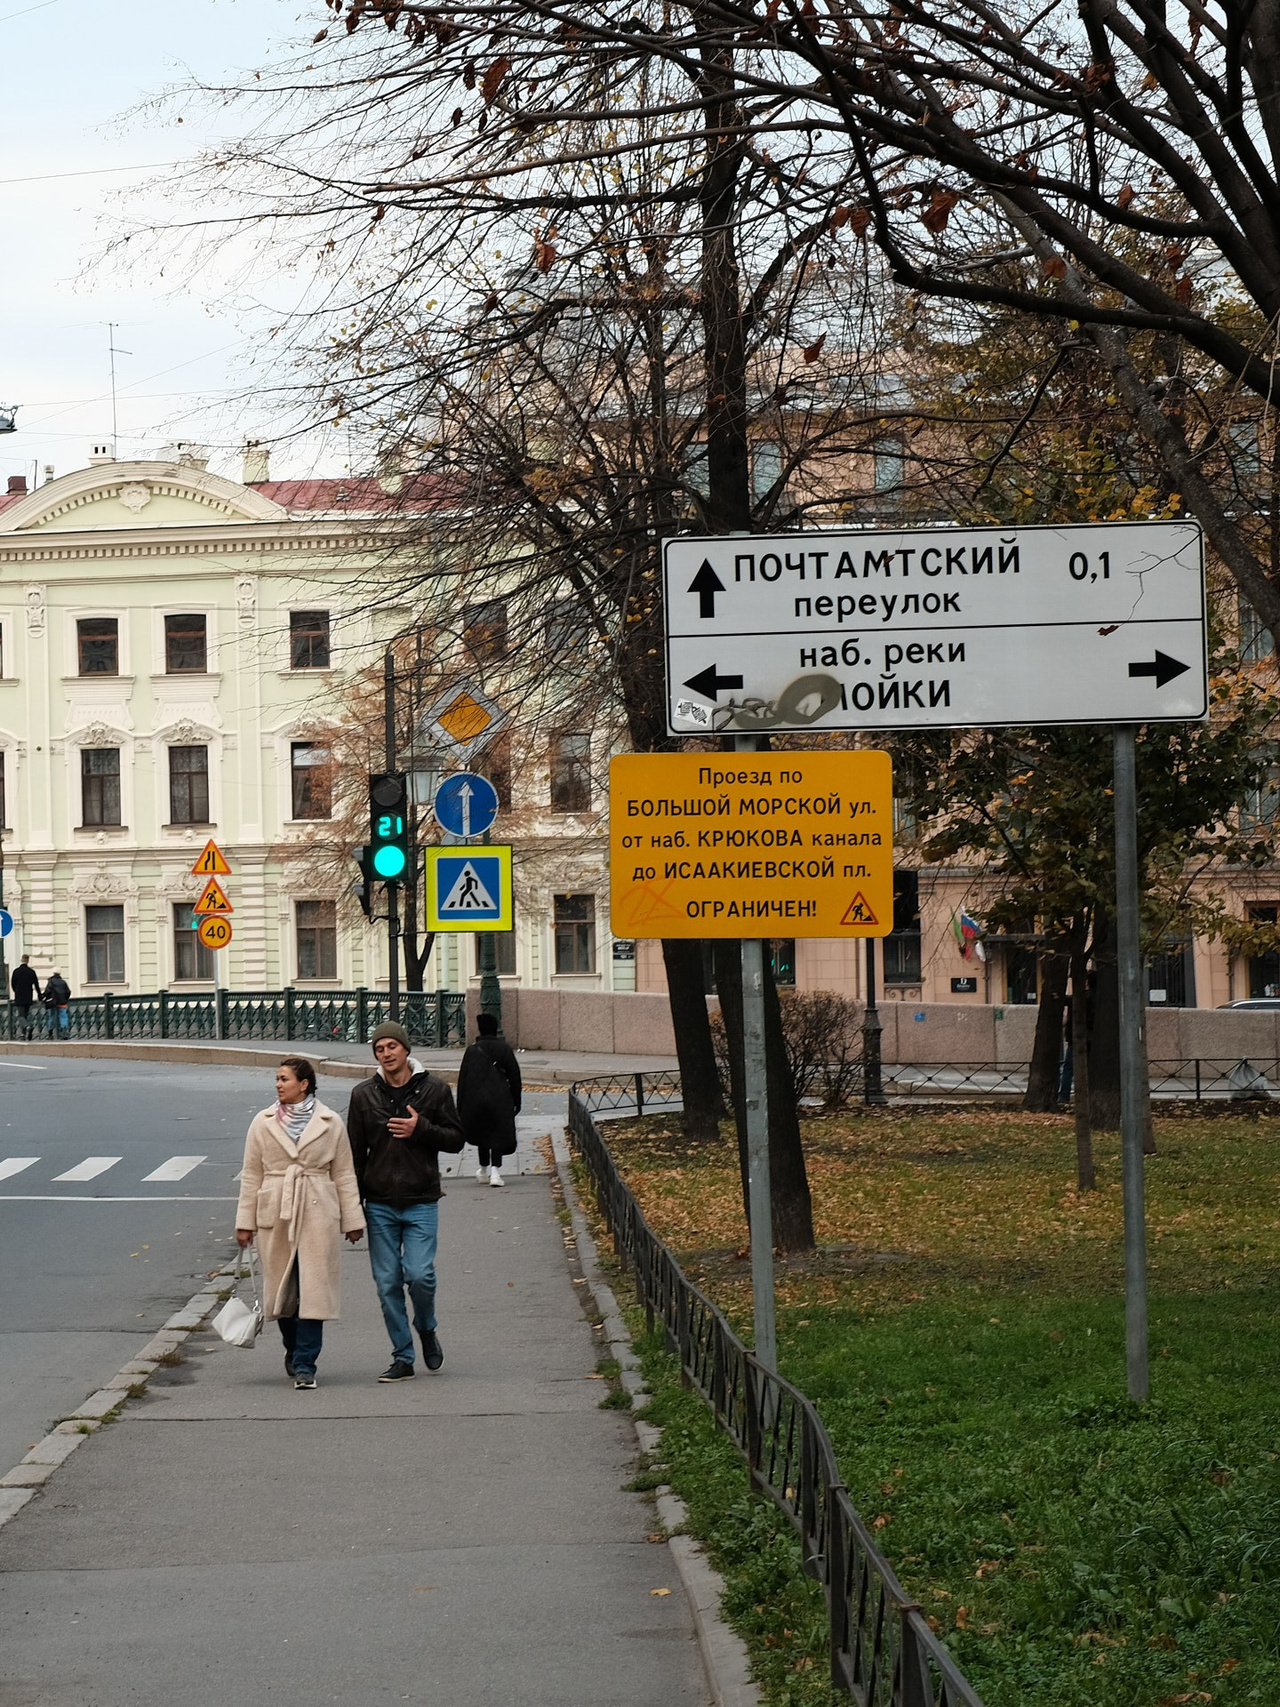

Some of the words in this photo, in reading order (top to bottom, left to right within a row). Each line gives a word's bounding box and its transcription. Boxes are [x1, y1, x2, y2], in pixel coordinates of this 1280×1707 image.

[733, 536, 1021, 583] ПОЧТАМТСКИЙ
[1068, 551, 1111, 584] 0,1
[793, 591, 963, 624] переулок
[799, 637, 873, 668] наб.
[883, 642, 967, 674] реки
[698, 767, 773, 789] Проезд
[779, 770, 804, 784] по
[626, 793, 731, 818] БОЛЬШОЙ
[738, 792, 842, 816] МОРСКОЙ
[848, 801, 877, 819] ул.
[378, 816, 403, 836] 21
[621, 834, 644, 849] от
[650, 830, 691, 849] наб.
[697, 829, 804, 848] КРЮКОВА
[811, 832, 883, 847] канала
[631, 866, 657, 882] до
[663, 855, 835, 880] ИСААКИЕВСКОЙ
[842, 865, 872, 878] пл.
[685, 899, 818, 919] ОГРАНИЧЕН!
[205, 925, 226, 939] 40
